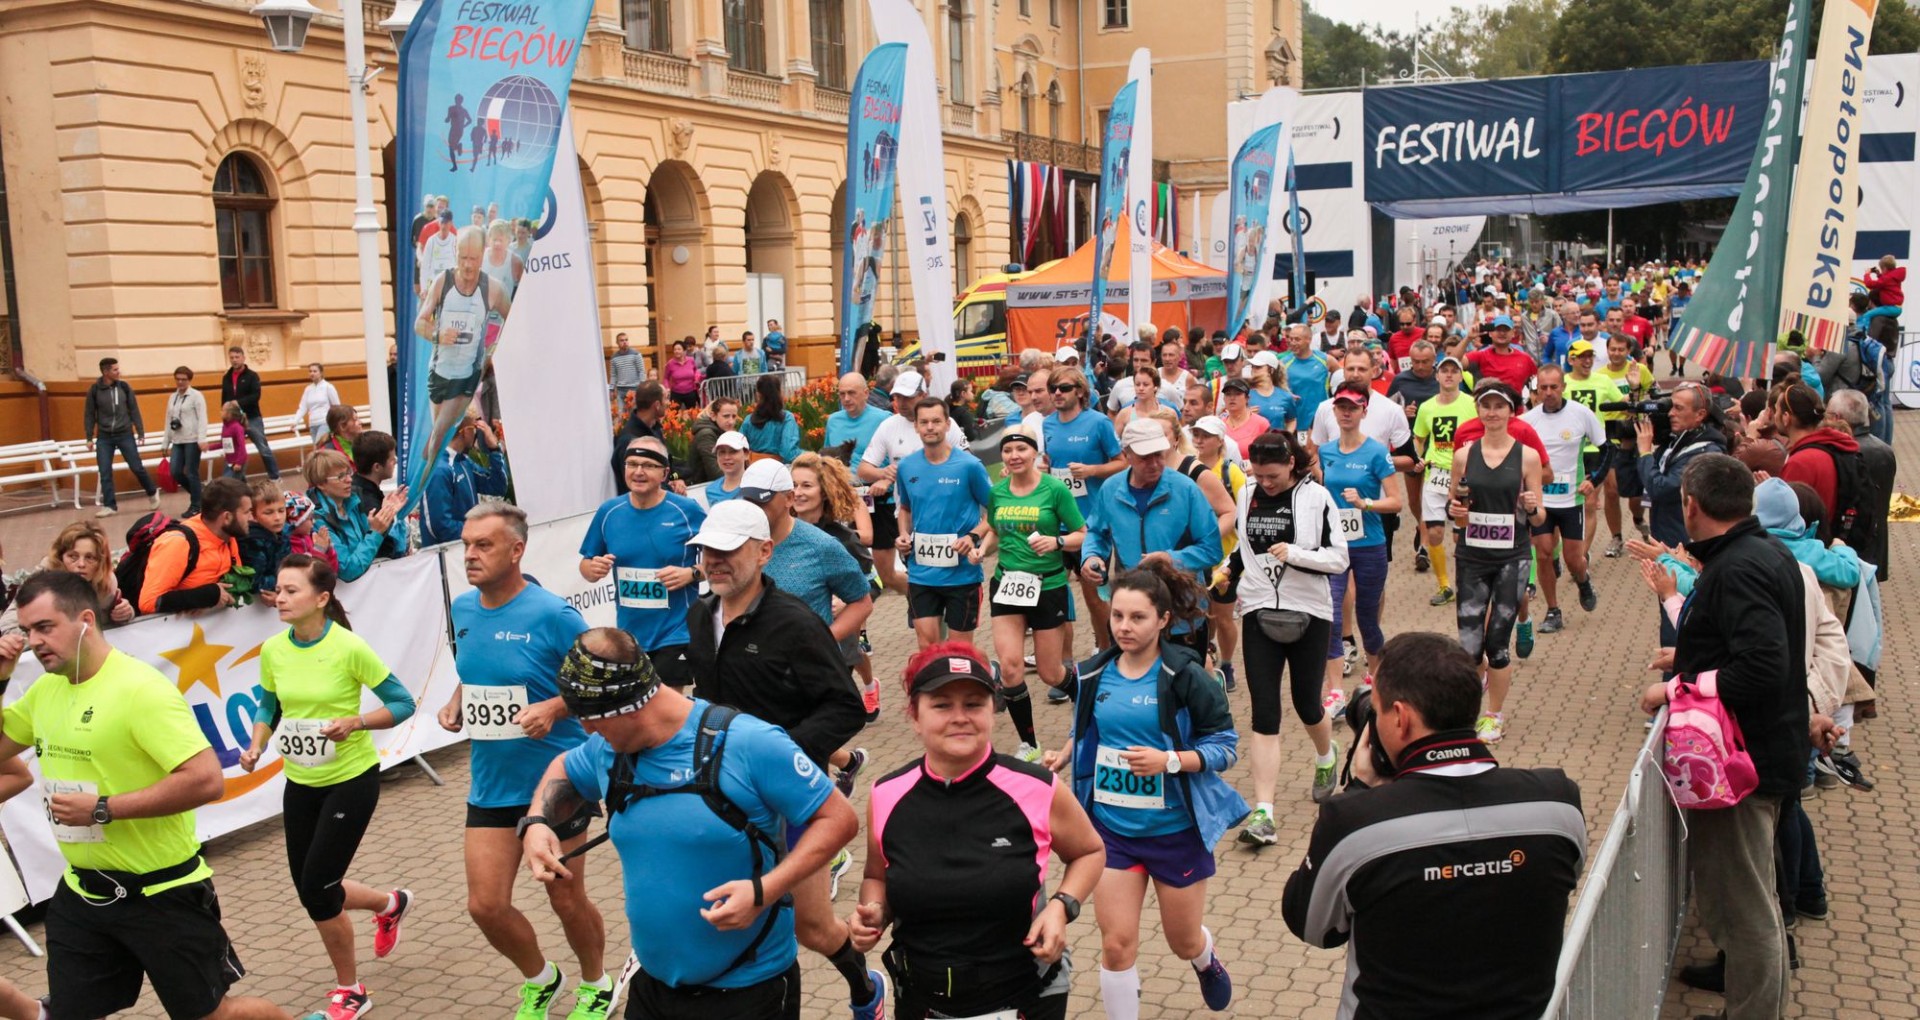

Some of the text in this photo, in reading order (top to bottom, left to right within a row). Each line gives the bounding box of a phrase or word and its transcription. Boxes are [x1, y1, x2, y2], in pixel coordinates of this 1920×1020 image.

[457, 0, 541, 26] FESTIWAL
[446, 24, 576, 69] BIEGÓW
[1862, 89, 1894, 97] ESTIWAL
[1376, 96, 1735, 169] FESTIWAL BIEGÓW
[1433, 223, 1471, 236] ZDROWIE
[1431, 475, 1452, 489] 448
[1543, 483, 1567, 495] 475
[1469, 525, 1511, 541] 2062
[918, 544, 955, 559] 4470
[566, 583, 616, 611] DROWIE
[621, 580, 664, 599] 2446
[1000, 582, 1036, 600] 4386
[466, 702, 522, 727] 3938
[279, 734, 329, 757] 3937
[1425, 747, 1471, 762] Canon
[1098, 766, 1157, 796] 2308
[1424, 859, 1514, 881] mercatis
